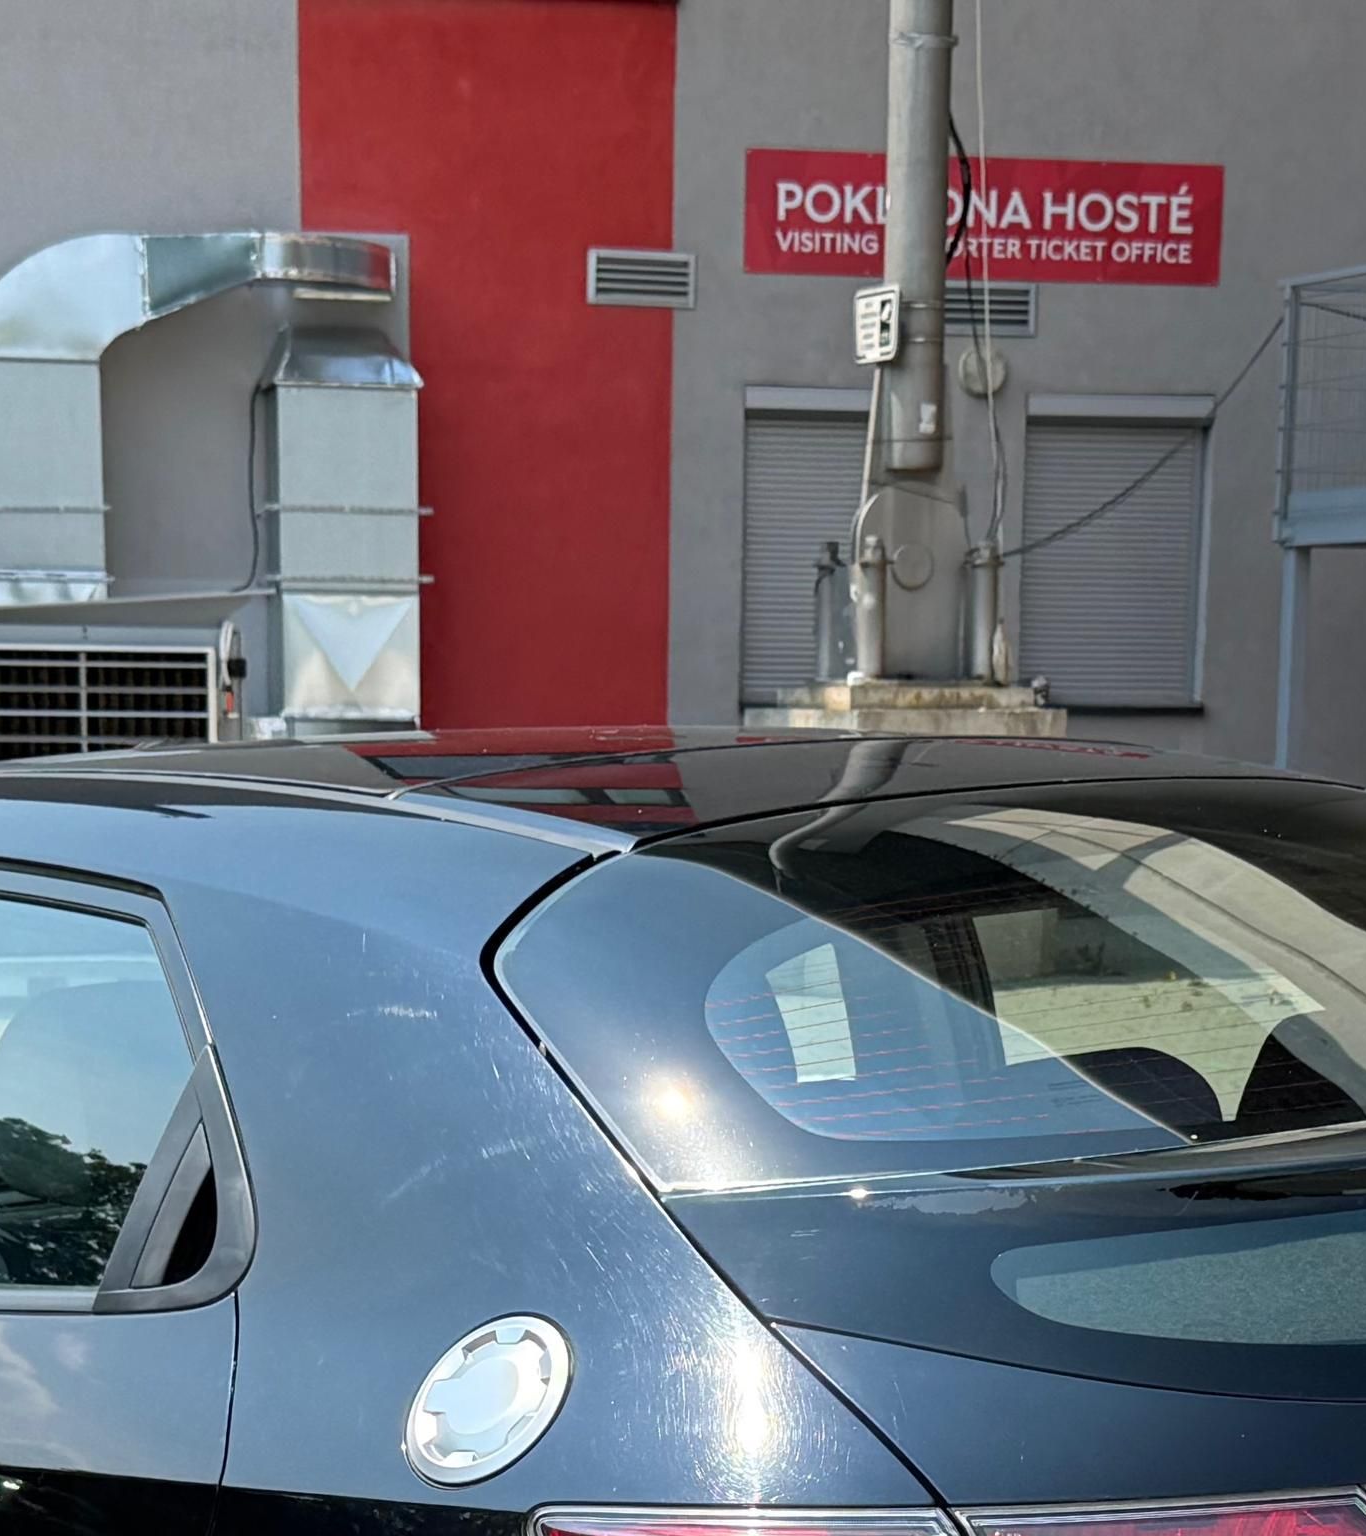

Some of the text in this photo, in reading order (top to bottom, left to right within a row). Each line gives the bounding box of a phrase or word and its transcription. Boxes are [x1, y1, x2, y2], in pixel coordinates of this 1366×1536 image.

[776, 182, 1193, 234] POKLNA HOSTÉ
[775, 230, 879, 255] VISITING
[1027, 239, 1106, 261] TICKET
[1110, 242, 1192, 264] OFFICE
